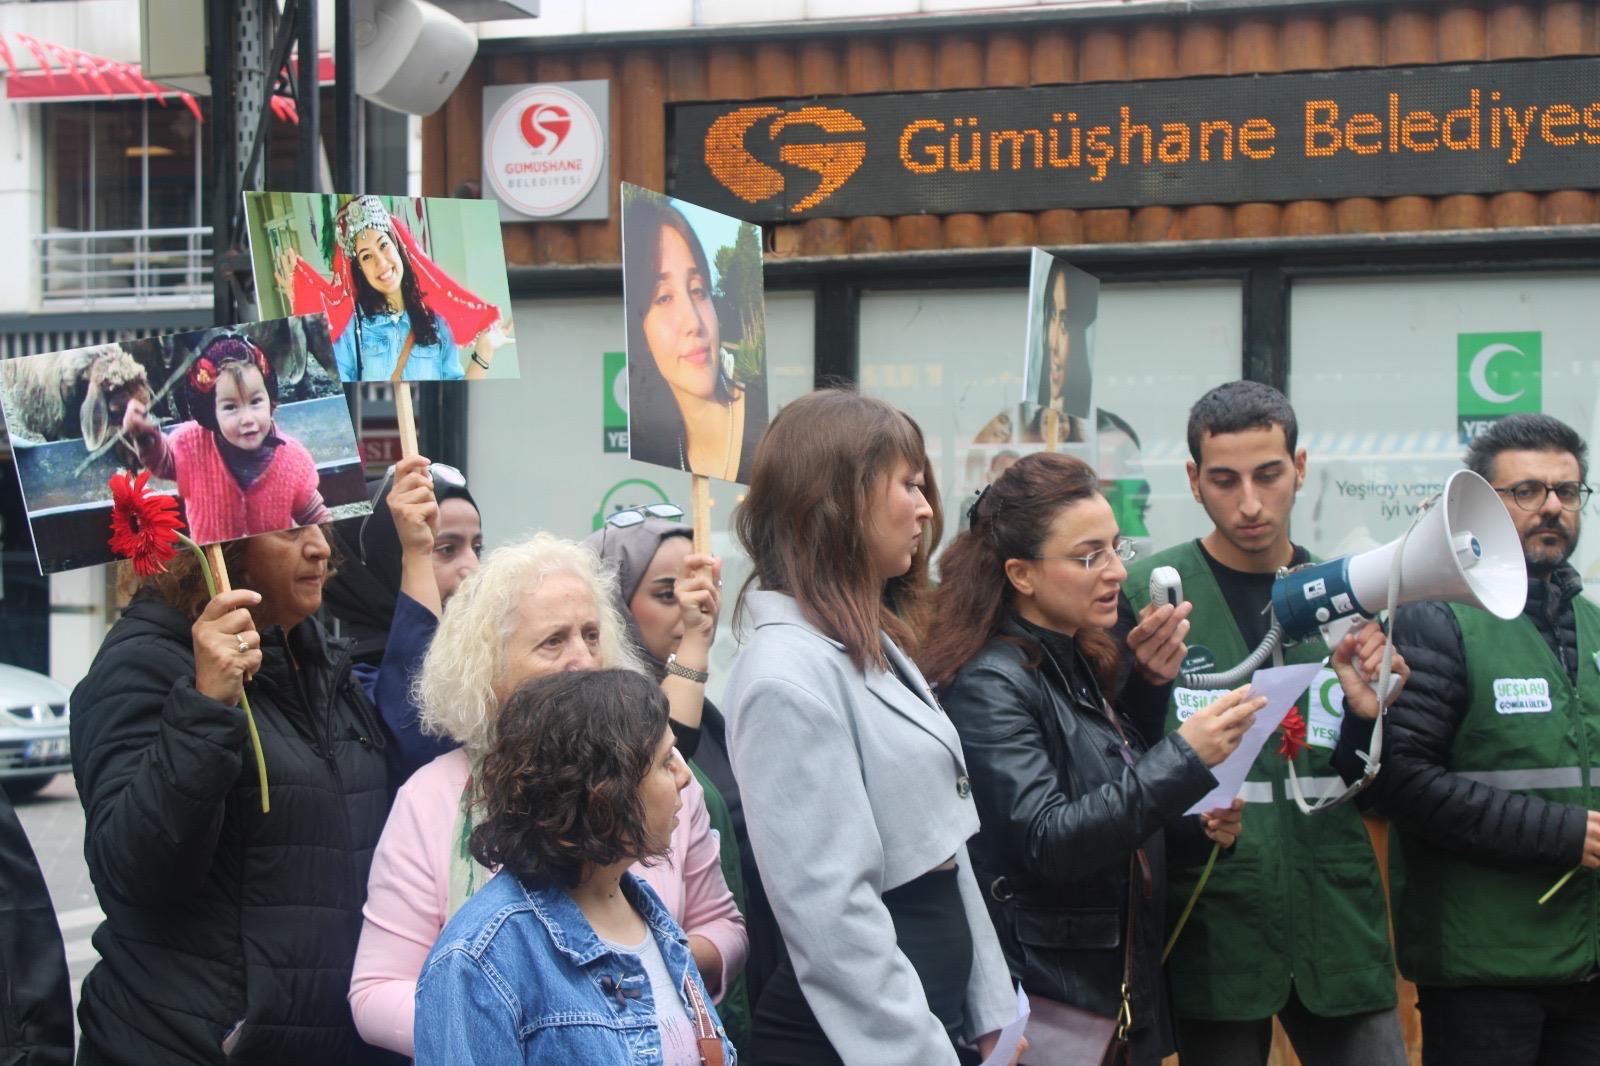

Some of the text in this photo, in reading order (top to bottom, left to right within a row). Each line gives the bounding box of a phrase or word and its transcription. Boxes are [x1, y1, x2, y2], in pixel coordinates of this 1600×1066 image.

[899, 88, 1600, 182] Gümüşhane Belediyes
[1336, 480, 1398, 500] Yeşilay
[1381, 500, 1400, 520] iyi
